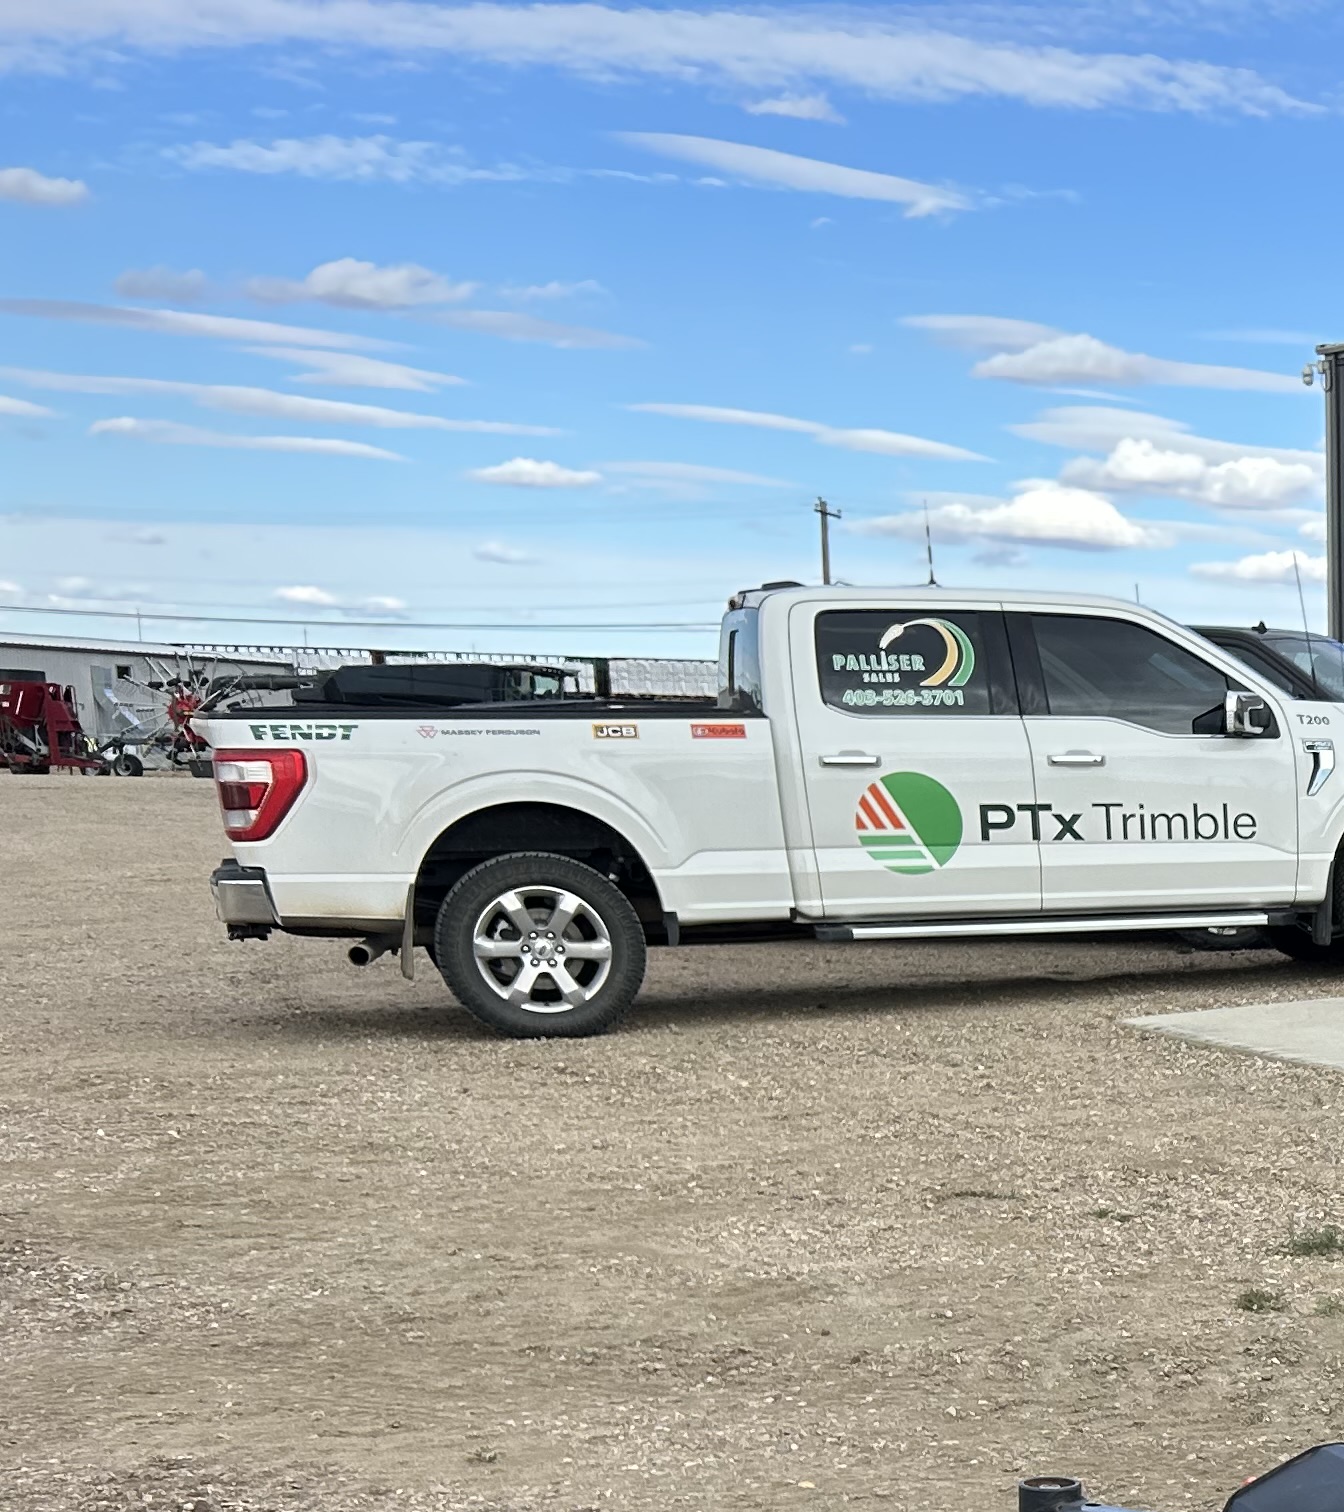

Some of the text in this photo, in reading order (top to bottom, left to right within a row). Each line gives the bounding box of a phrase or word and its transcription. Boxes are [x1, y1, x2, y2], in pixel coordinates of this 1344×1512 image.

[832, 650, 926, 671] PALLISER
[863, 672, 901, 683] SALES
[842, 689, 965, 706] 403-526-3701
[1296, 714, 1331, 726] T200
[248, 724, 359, 741] FENDT
[597, 725, 636, 738] JCB
[979, 803, 1257, 841] PTx Trimble
